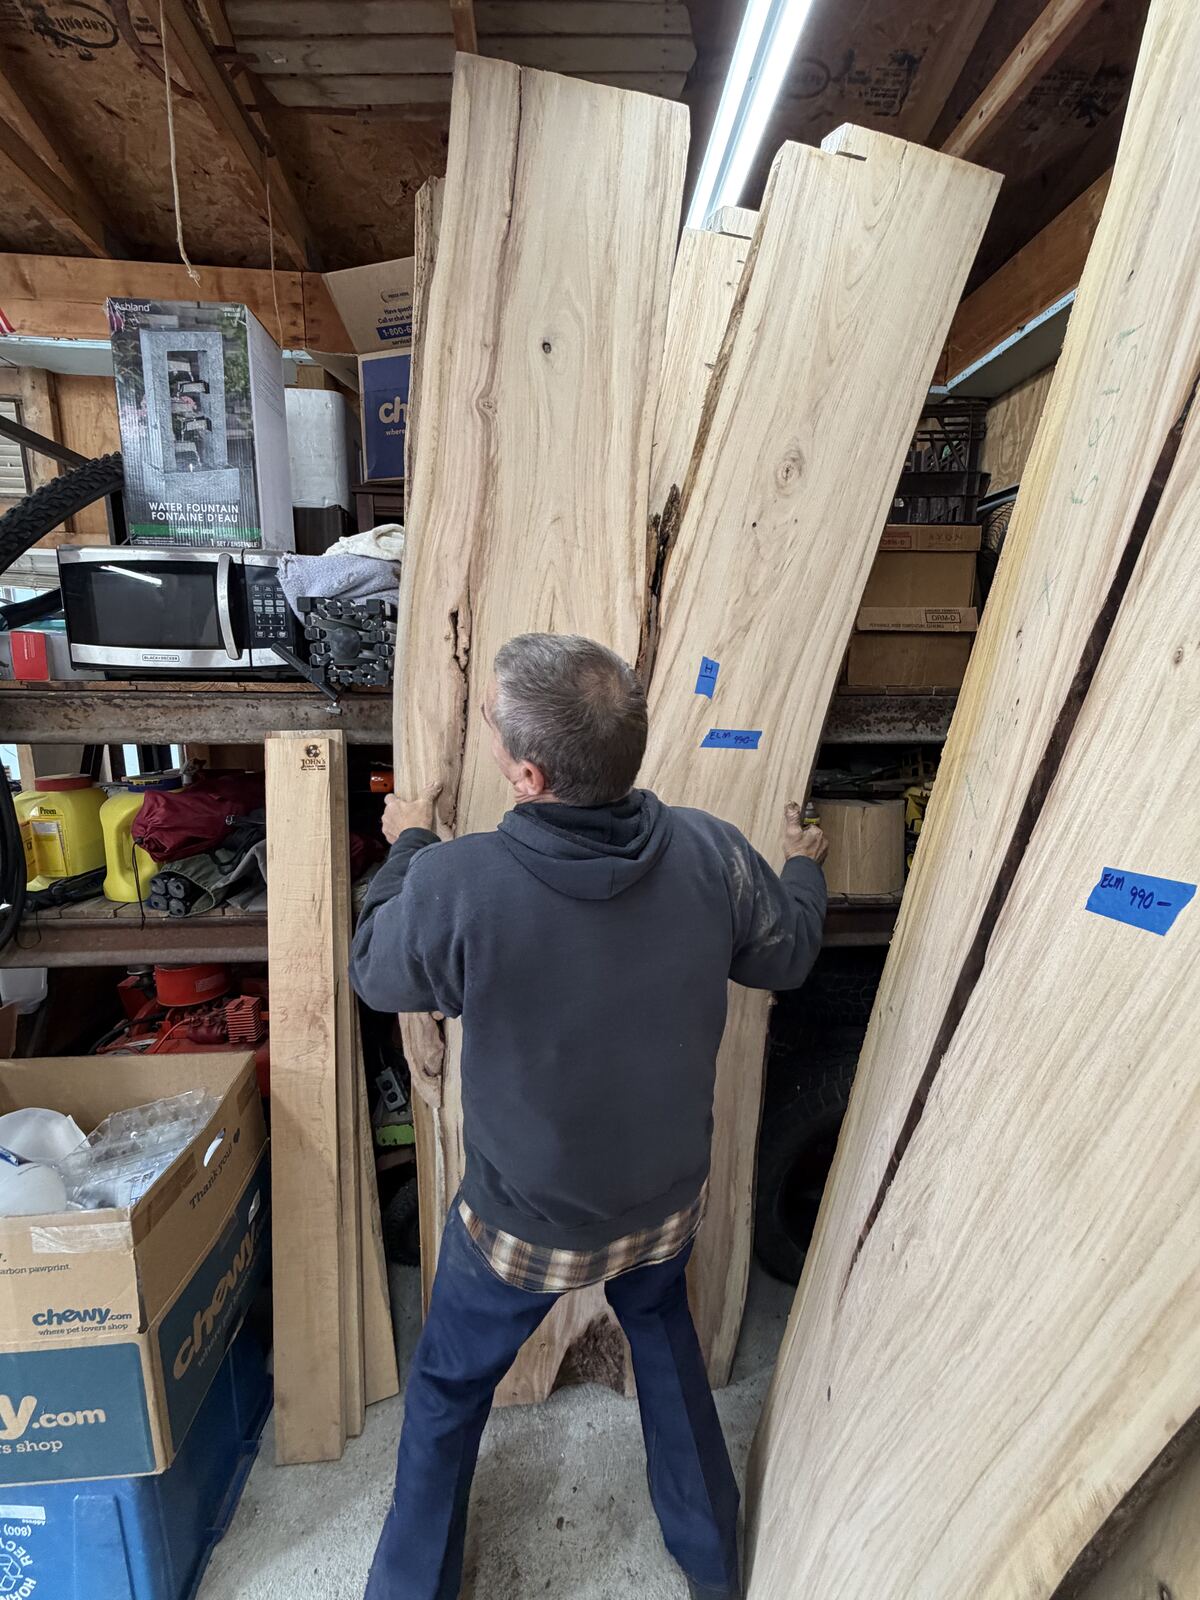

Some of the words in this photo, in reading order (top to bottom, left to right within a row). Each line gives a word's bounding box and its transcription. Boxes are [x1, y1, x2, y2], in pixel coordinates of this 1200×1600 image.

[148, 502, 183, 512] WATER
[186, 503, 239, 513] FOUNTAIN
[151, 511, 203, 522] FONTAINE
[207, 513, 238, 523] D'EAU
[709, 731, 731, 740] ELM
[40, 806, 57, 815] Preen
[1100, 873, 1124, 891] ELM
[189, 1168, 218, 1210] Thank
[31, 1307, 133, 1326] chewy.com
[38, 1328, 65, 1336] where
[66, 1325, 80, 1335] pet
[81, 1324, 107, 1332] lovers
[107, 1323, 129, 1331] shop
[16, 1440, 63, 1453] shop
[3, 1523, 32, 1537] (800)
